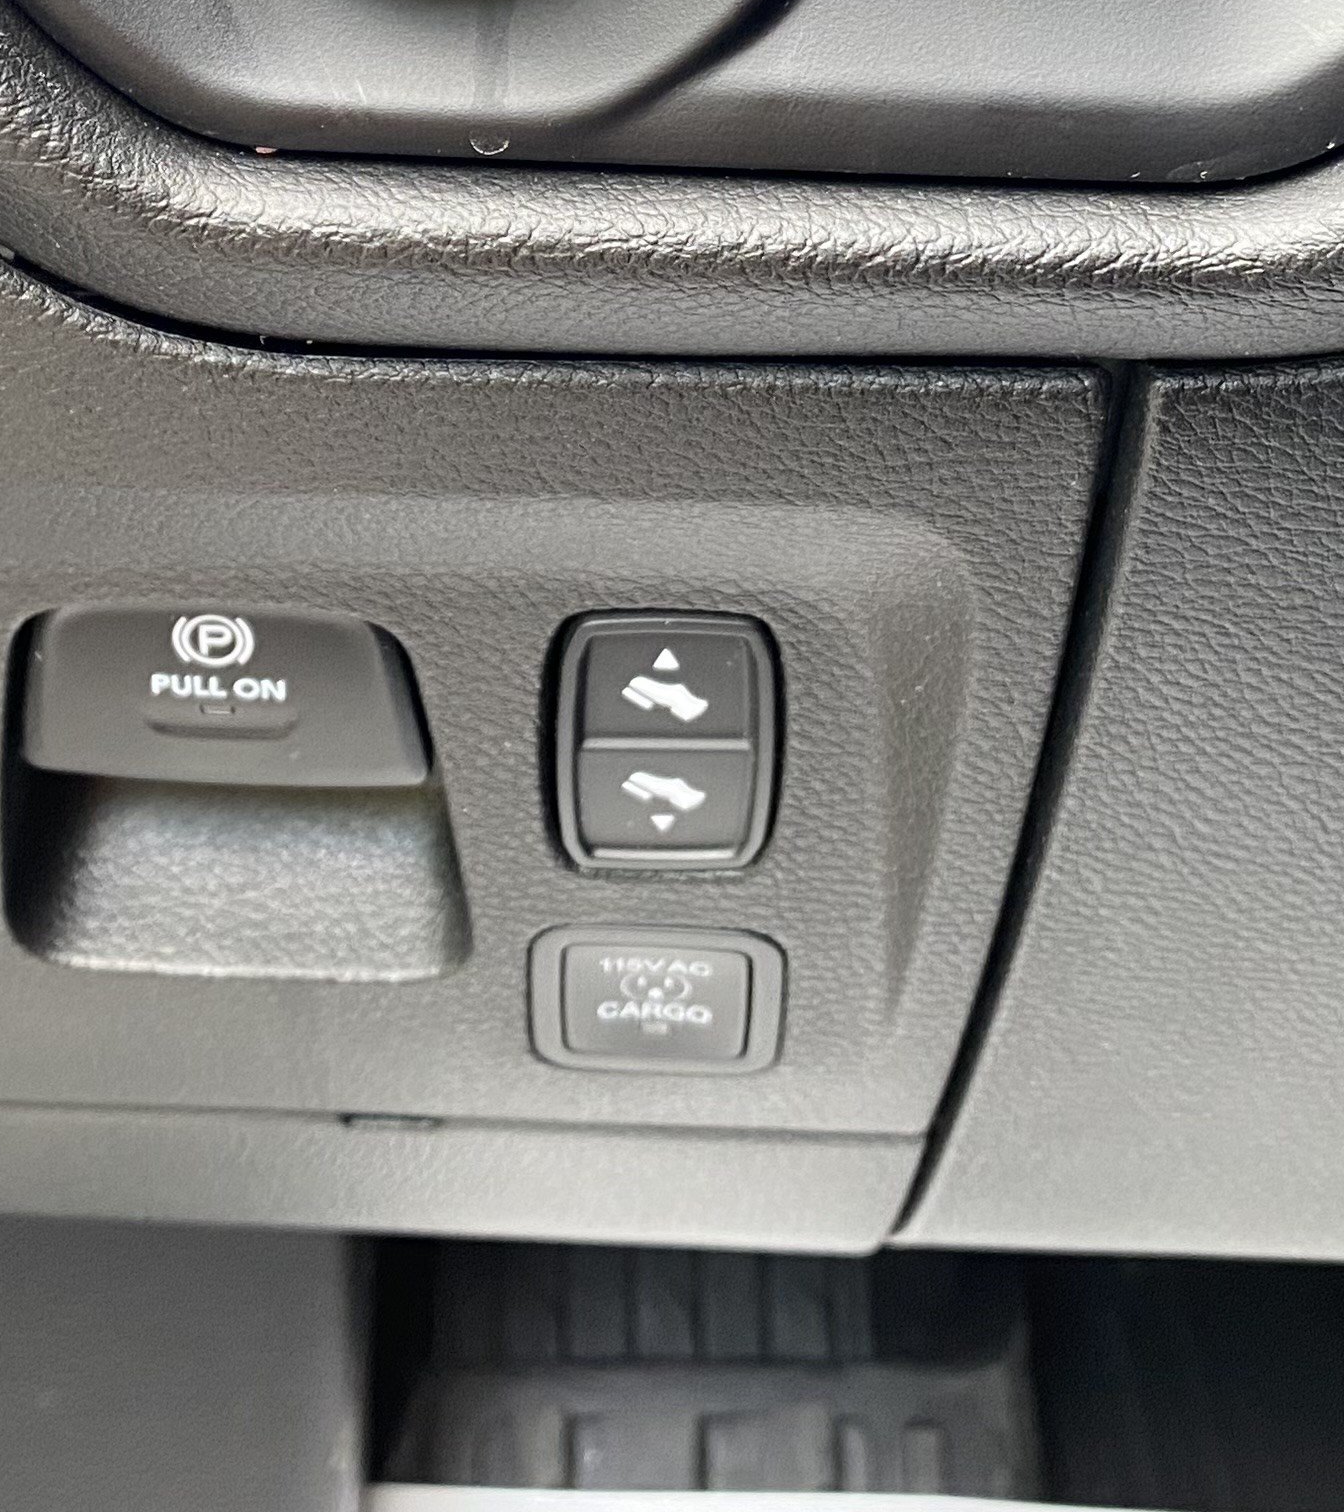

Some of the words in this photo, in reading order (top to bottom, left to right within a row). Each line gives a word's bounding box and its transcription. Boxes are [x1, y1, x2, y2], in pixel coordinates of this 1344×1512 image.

[150, 673, 227, 699] PULL
[233, 677, 287, 702] ON
[596, 1000, 713, 1024] CARGO
